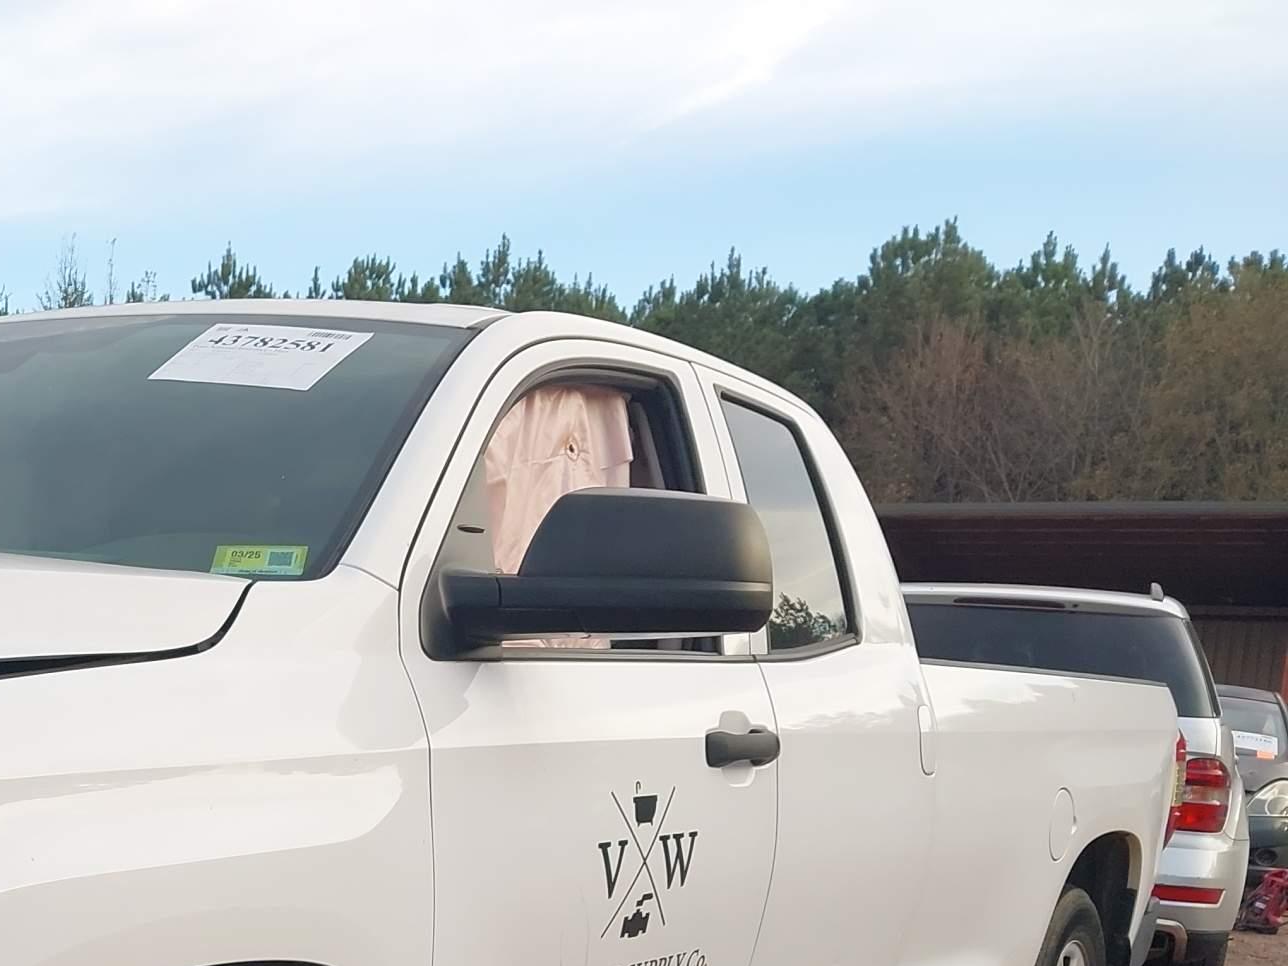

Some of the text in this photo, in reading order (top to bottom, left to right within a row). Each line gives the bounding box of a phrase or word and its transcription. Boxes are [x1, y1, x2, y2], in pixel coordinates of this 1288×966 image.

[209, 335, 335, 352] 43782581
[231, 550, 261, 559] 03/25
[598, 831, 698, 899] V W
